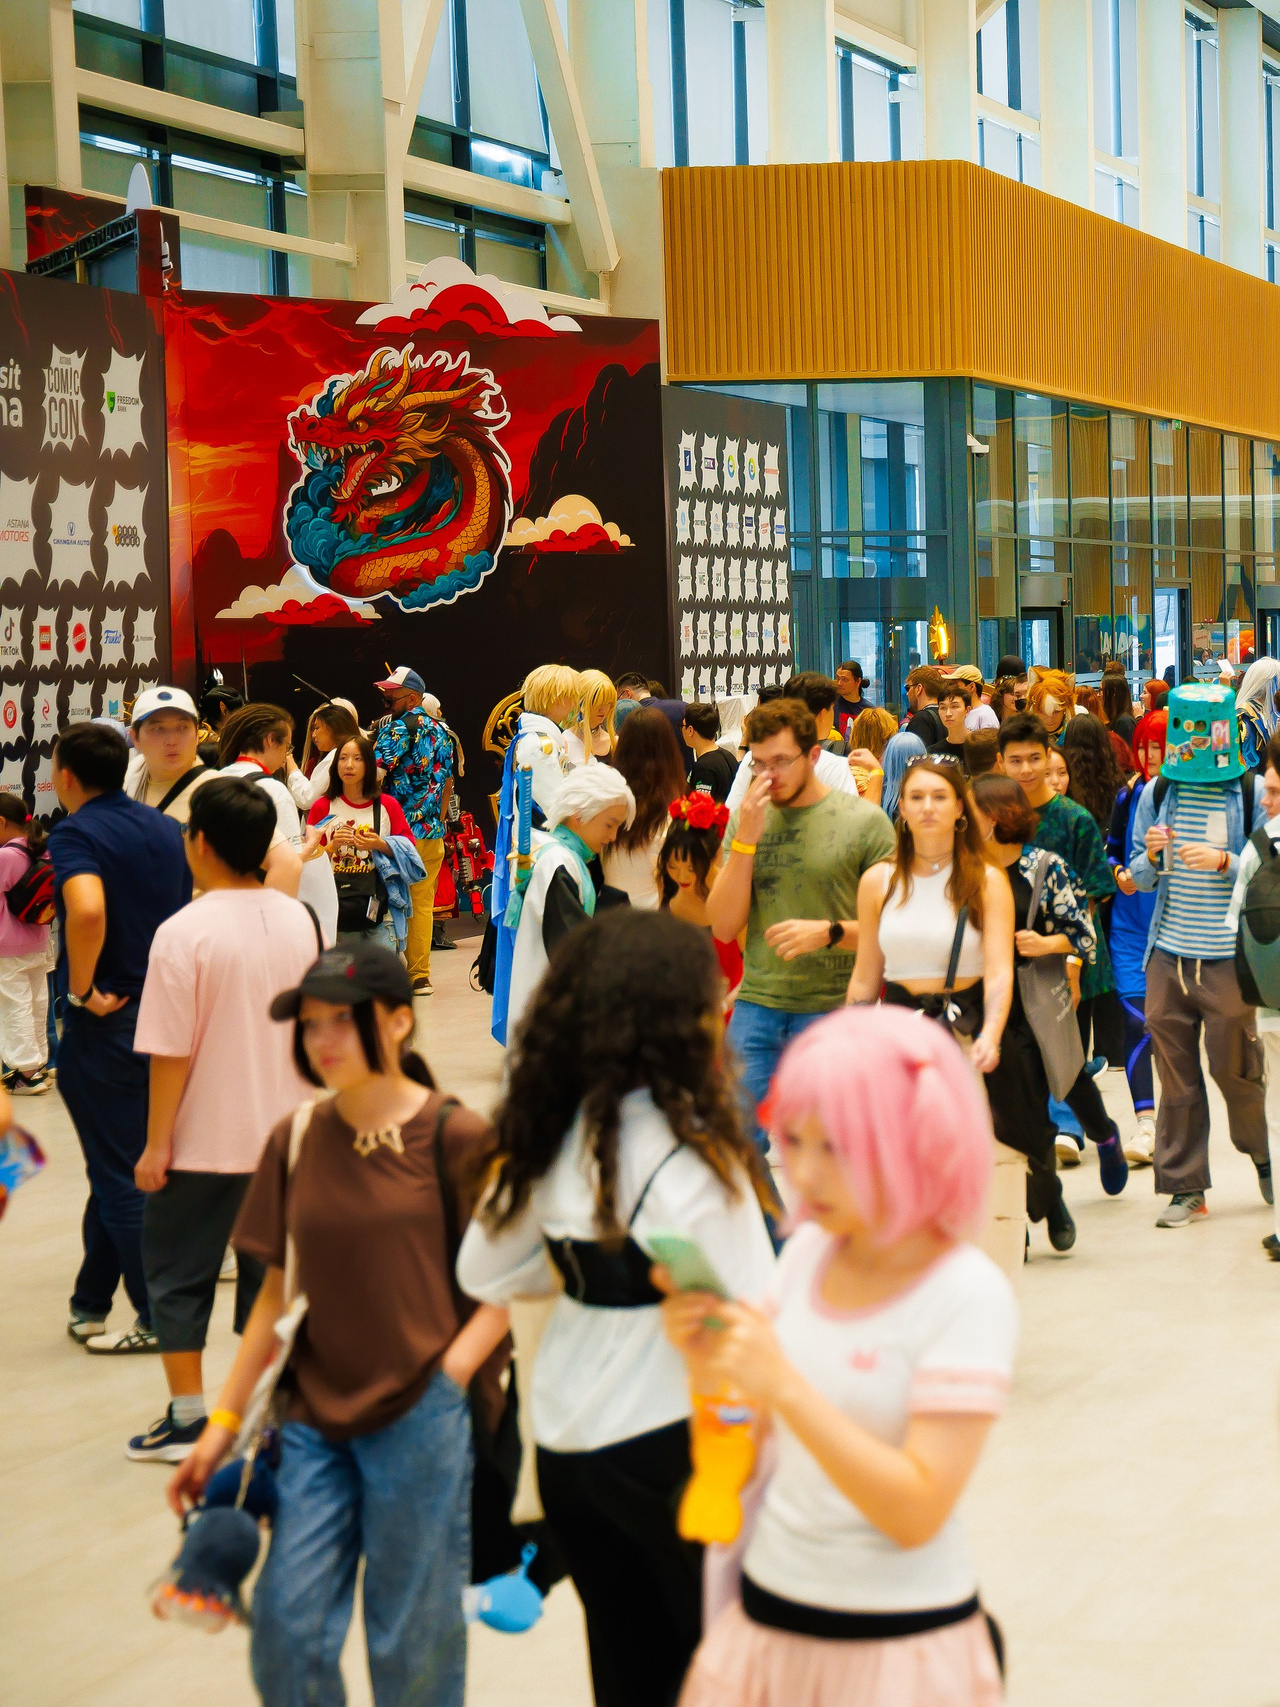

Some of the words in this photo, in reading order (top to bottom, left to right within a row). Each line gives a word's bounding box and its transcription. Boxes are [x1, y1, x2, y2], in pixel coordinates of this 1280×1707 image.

[117, 395, 140, 407] FREEDOM
[48, 396, 80, 440] CON
[7, 518, 30, 529] ASTANA
[0, 645, 20, 656] TikTok
